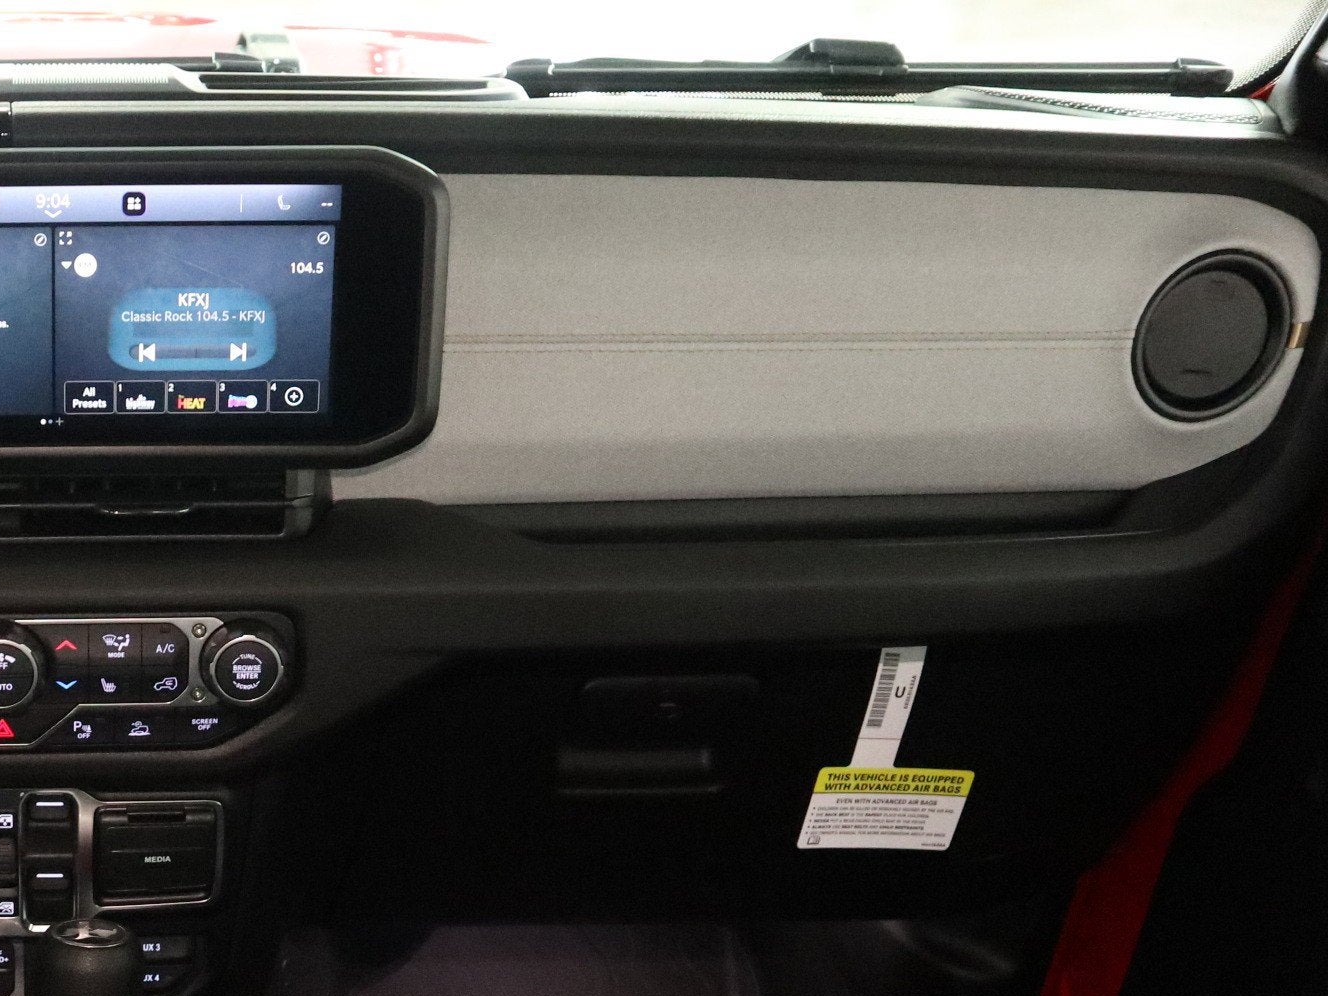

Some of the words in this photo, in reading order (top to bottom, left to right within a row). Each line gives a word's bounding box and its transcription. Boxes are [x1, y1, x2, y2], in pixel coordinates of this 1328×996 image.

[36, 193, 71, 208] 9:04
[291, 262, 323, 274] 104.5
[178, 293, 209, 310] KFXJ
[122, 311, 161, 322] Classic
[164, 311, 192, 321] Rock
[197, 311, 229, 321] 104.5
[239, 311, 266, 323] KFXJ
[82, 387, 95, 397] All
[168, 384, 174, 392] 2
[220, 383, 225, 392] 3
[271, 383, 277, 391] 4
[72, 397, 107, 409] Presets
[178, 398, 206, 409] HEAT
[156, 644, 175, 653] A/C
[236, 672, 259, 680] ENTER
[235, 682, 258, 690] SCROLL
[895, 686, 906, 698] U
[73, 721, 82, 732] P
[854, 773, 897, 782] VEHICLE
[912, 775, 965, 784] EQUIPPED
[853, 783, 910, 791] ADVANCED
[933, 785, 961, 793] BAGS
[155, 943, 161, 951] 3
[154, 974, 160, 982] 4
